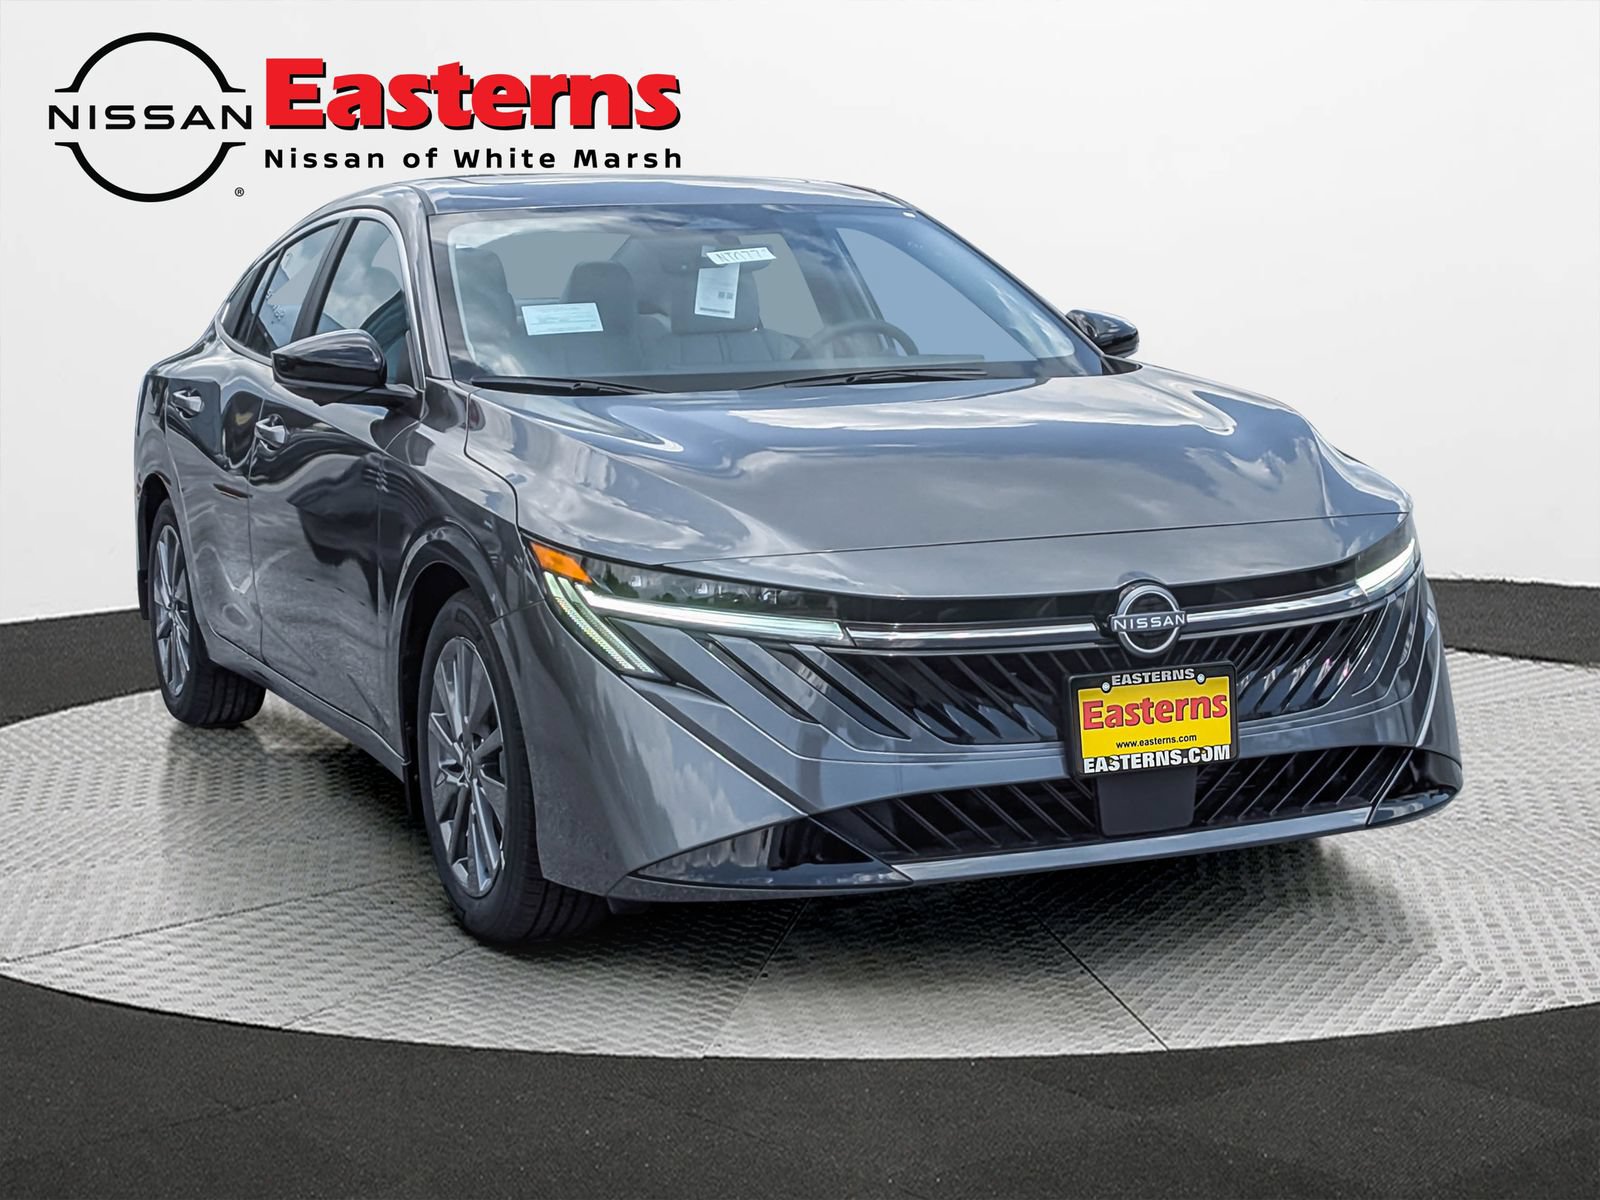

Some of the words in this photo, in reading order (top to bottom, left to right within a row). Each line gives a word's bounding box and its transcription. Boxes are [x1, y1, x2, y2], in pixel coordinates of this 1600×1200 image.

[1113, 613, 1185, 631] NISSAN
[1111, 668, 1195, 686] EASTERNS
[1082, 694, 1228, 731] Easterns
[1116, 734, 1197, 749] www.easterns.com
[1083, 744, 1231, 774] EASTERNS.COM
